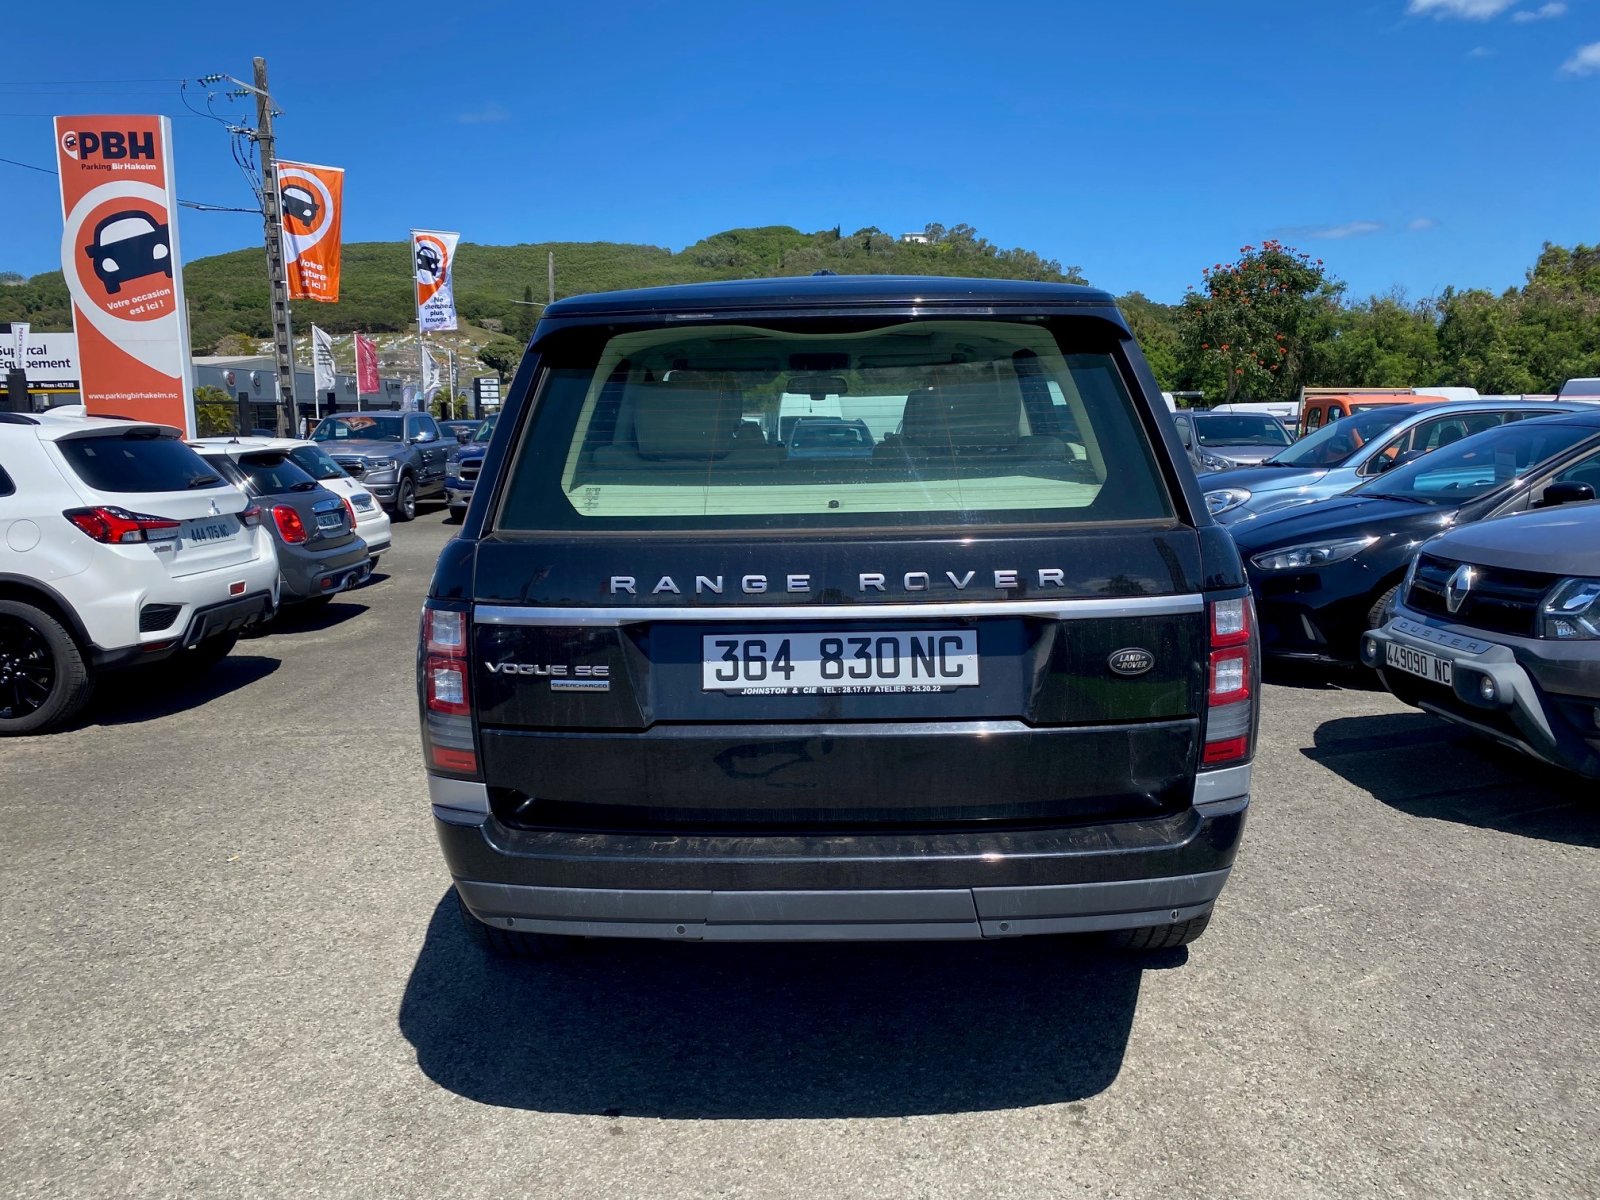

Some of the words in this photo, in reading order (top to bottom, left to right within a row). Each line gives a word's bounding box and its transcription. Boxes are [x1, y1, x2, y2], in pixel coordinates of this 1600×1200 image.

[78, 131, 155, 160] PBH
[301, 269, 327, 281] oiture
[107, 299, 130, 310] Votre
[132, 288, 171, 304] occasion
[129, 305, 146, 315] est
[146, 301, 159, 311] ici
[88, 391, 178, 400] www.parkingbirhakeim.nc
[191, 527, 206, 542] 444
[206, 525, 220, 540] 175
[218, 524, 230, 538] NC
[610, 574, 811, 594] RANGE
[858, 567, 1065, 592] ROVER
[1400, 622, 1479, 650] DUSTER
[485, 661, 568, 676] VOGUE
[574, 665, 610, 676] SE
[715, 638, 795, 682] 364
[820, 636, 901, 681] 830
[910, 635, 964, 679] NC
[1387, 644, 1428, 676] 449090
[1434, 658, 1450, 684] NC
[741, 687, 788, 695] JOHNSTON
[874, 685, 906, 693] ATELIER
